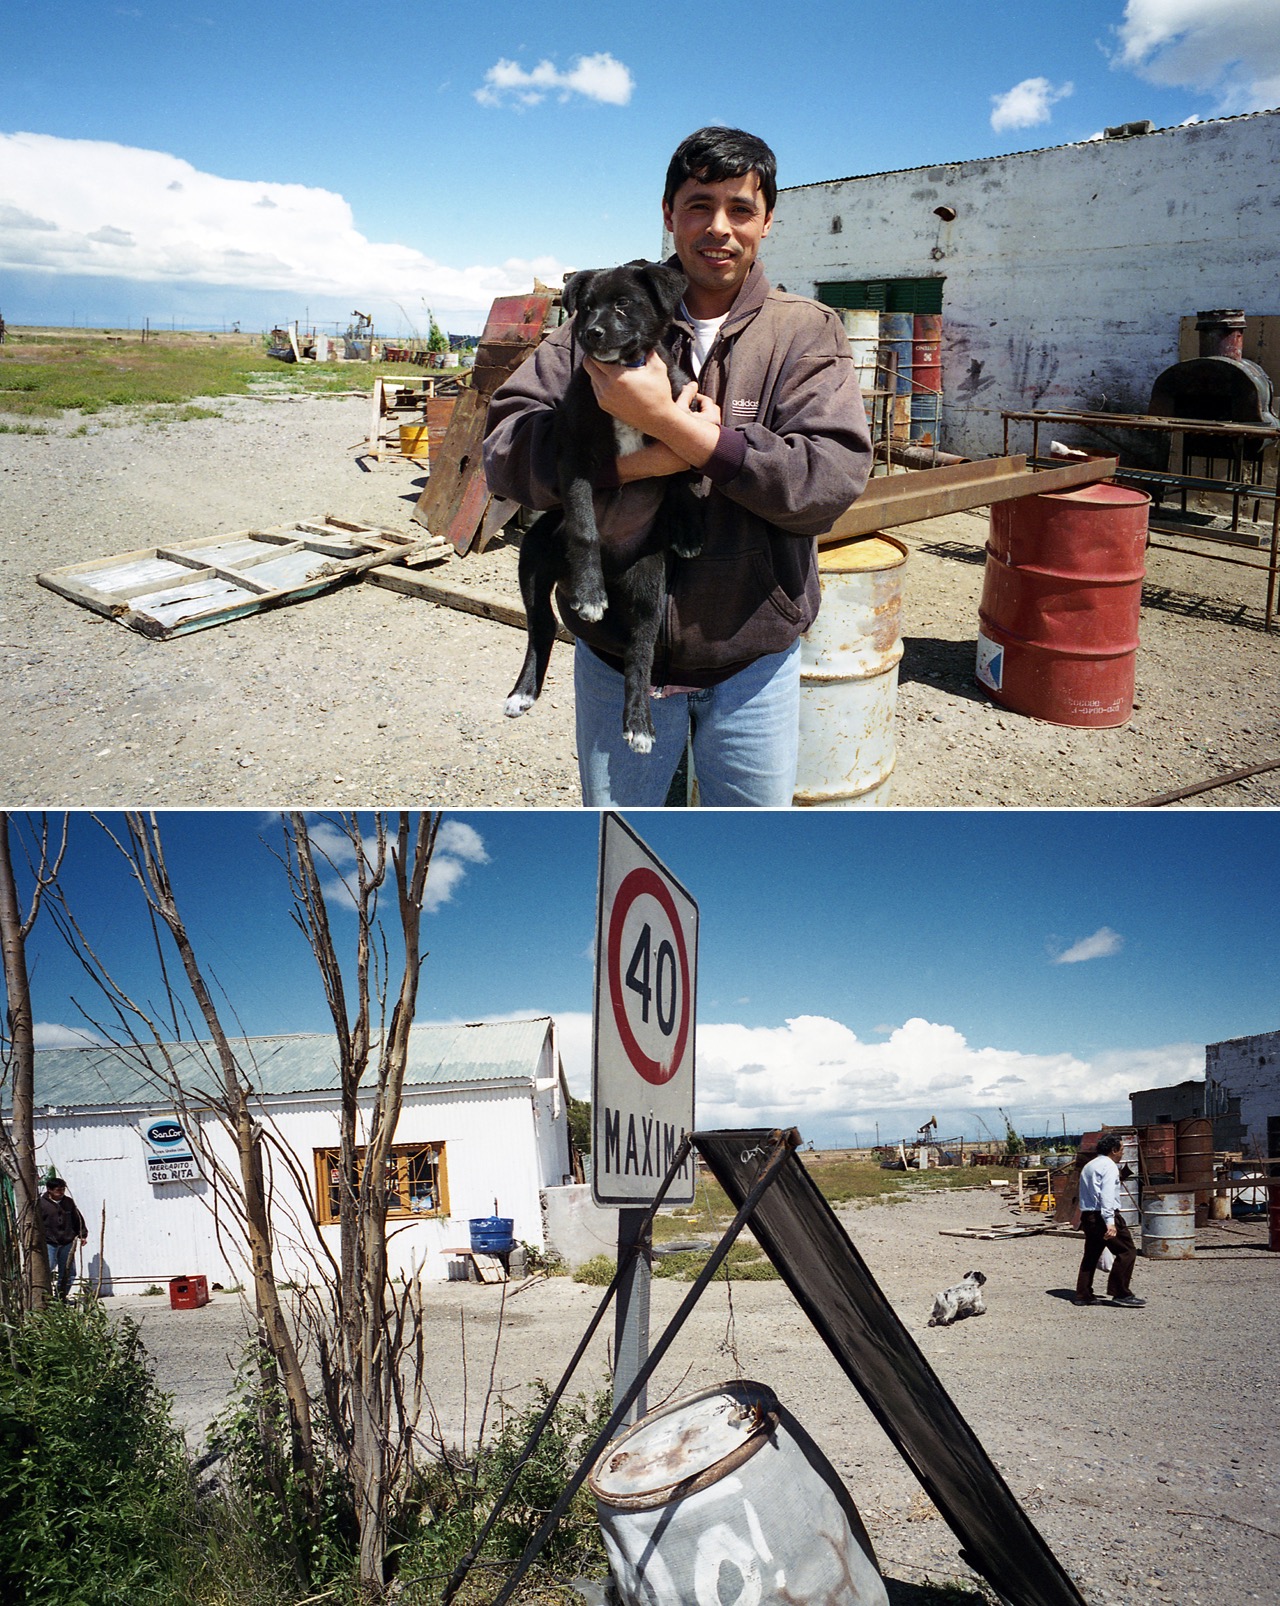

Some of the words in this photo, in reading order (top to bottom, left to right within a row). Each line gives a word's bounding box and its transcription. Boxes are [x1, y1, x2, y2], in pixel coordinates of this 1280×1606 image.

[625, 922, 677, 1037] 40
[152, 1129, 182, 1138] SanCor
[171, 1169, 193, 1178] RITA
